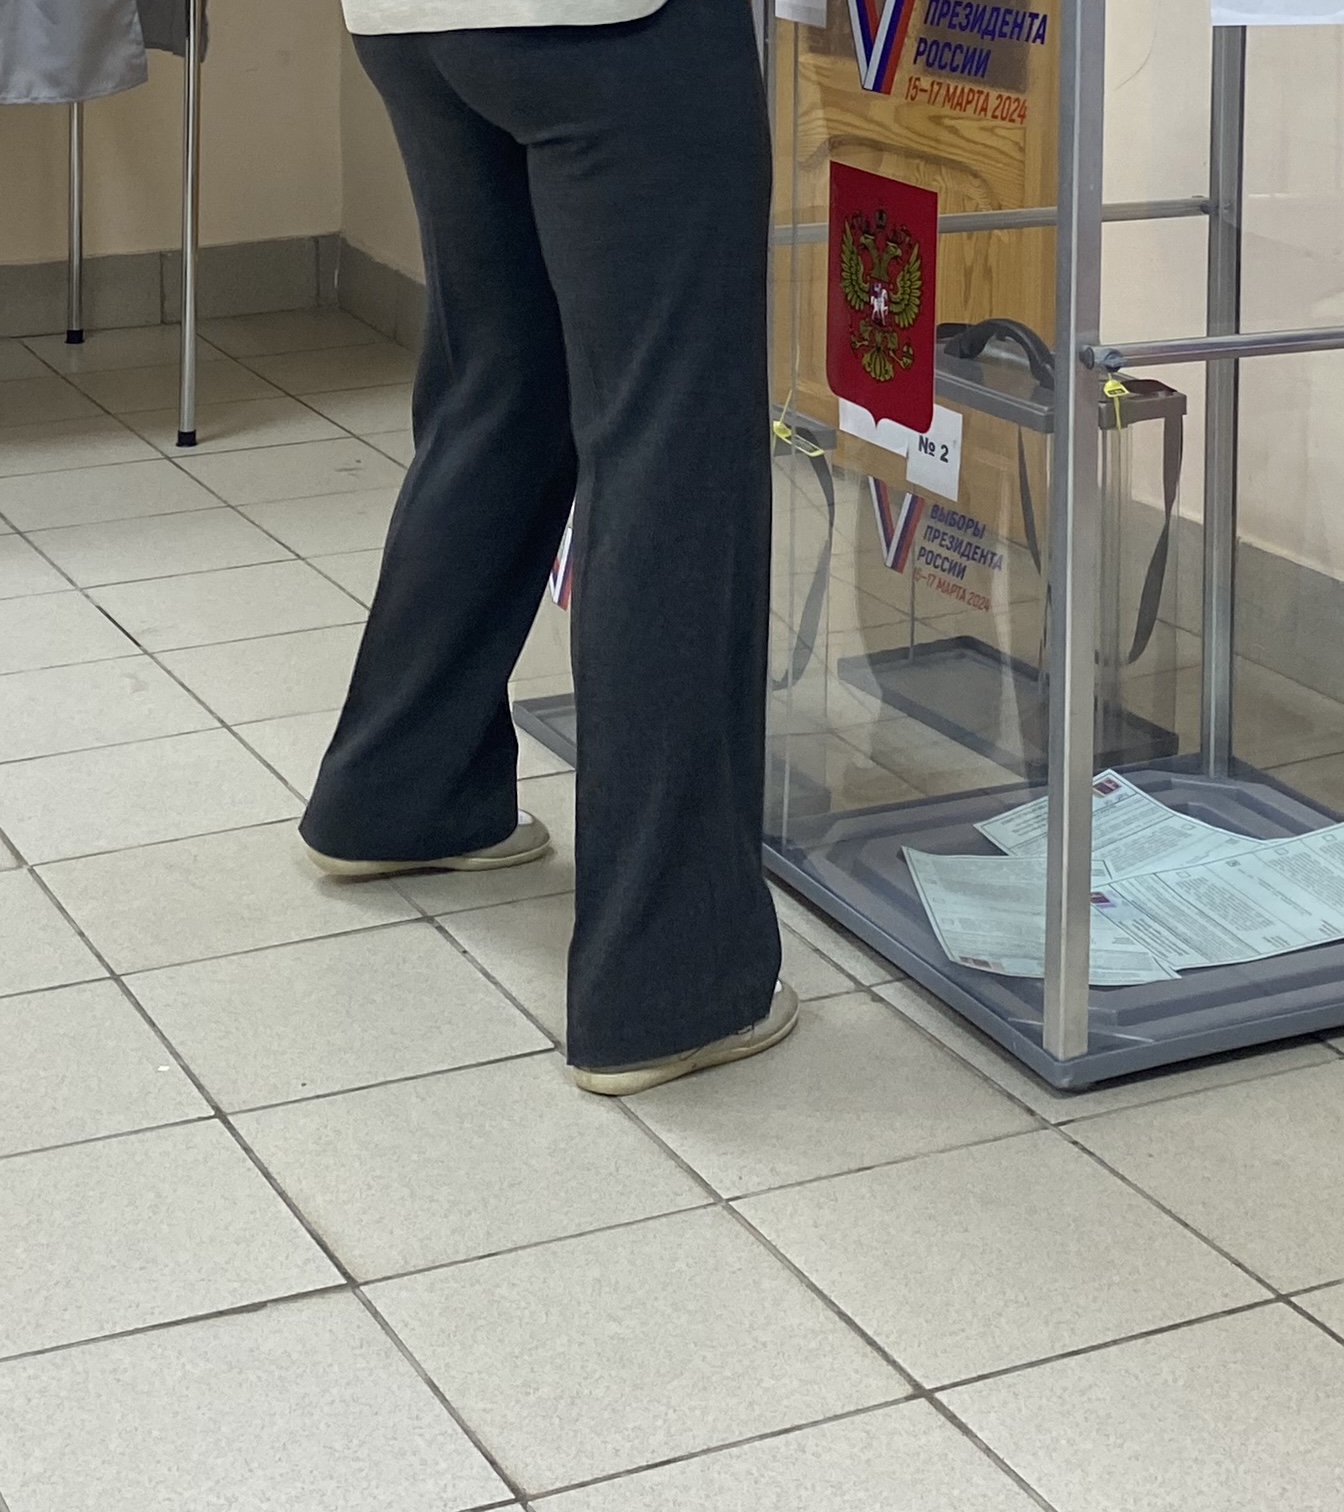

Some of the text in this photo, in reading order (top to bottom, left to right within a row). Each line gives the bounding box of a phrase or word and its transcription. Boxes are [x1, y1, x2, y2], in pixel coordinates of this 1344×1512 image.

[913, 38, 992, 79] РОССИИ
[943, 84, 990, 120] МАРТА
[991, 94, 1028, 125] 2024
[939, 445, 949, 463] 2
[930, 503, 986, 539] ВЫБОРЫ
[917, 546, 967, 581] РОССИИ
[923, 525, 1004, 571] ПРЕЗИДЕНТА
[936, 578, 967, 603] МАРТА
